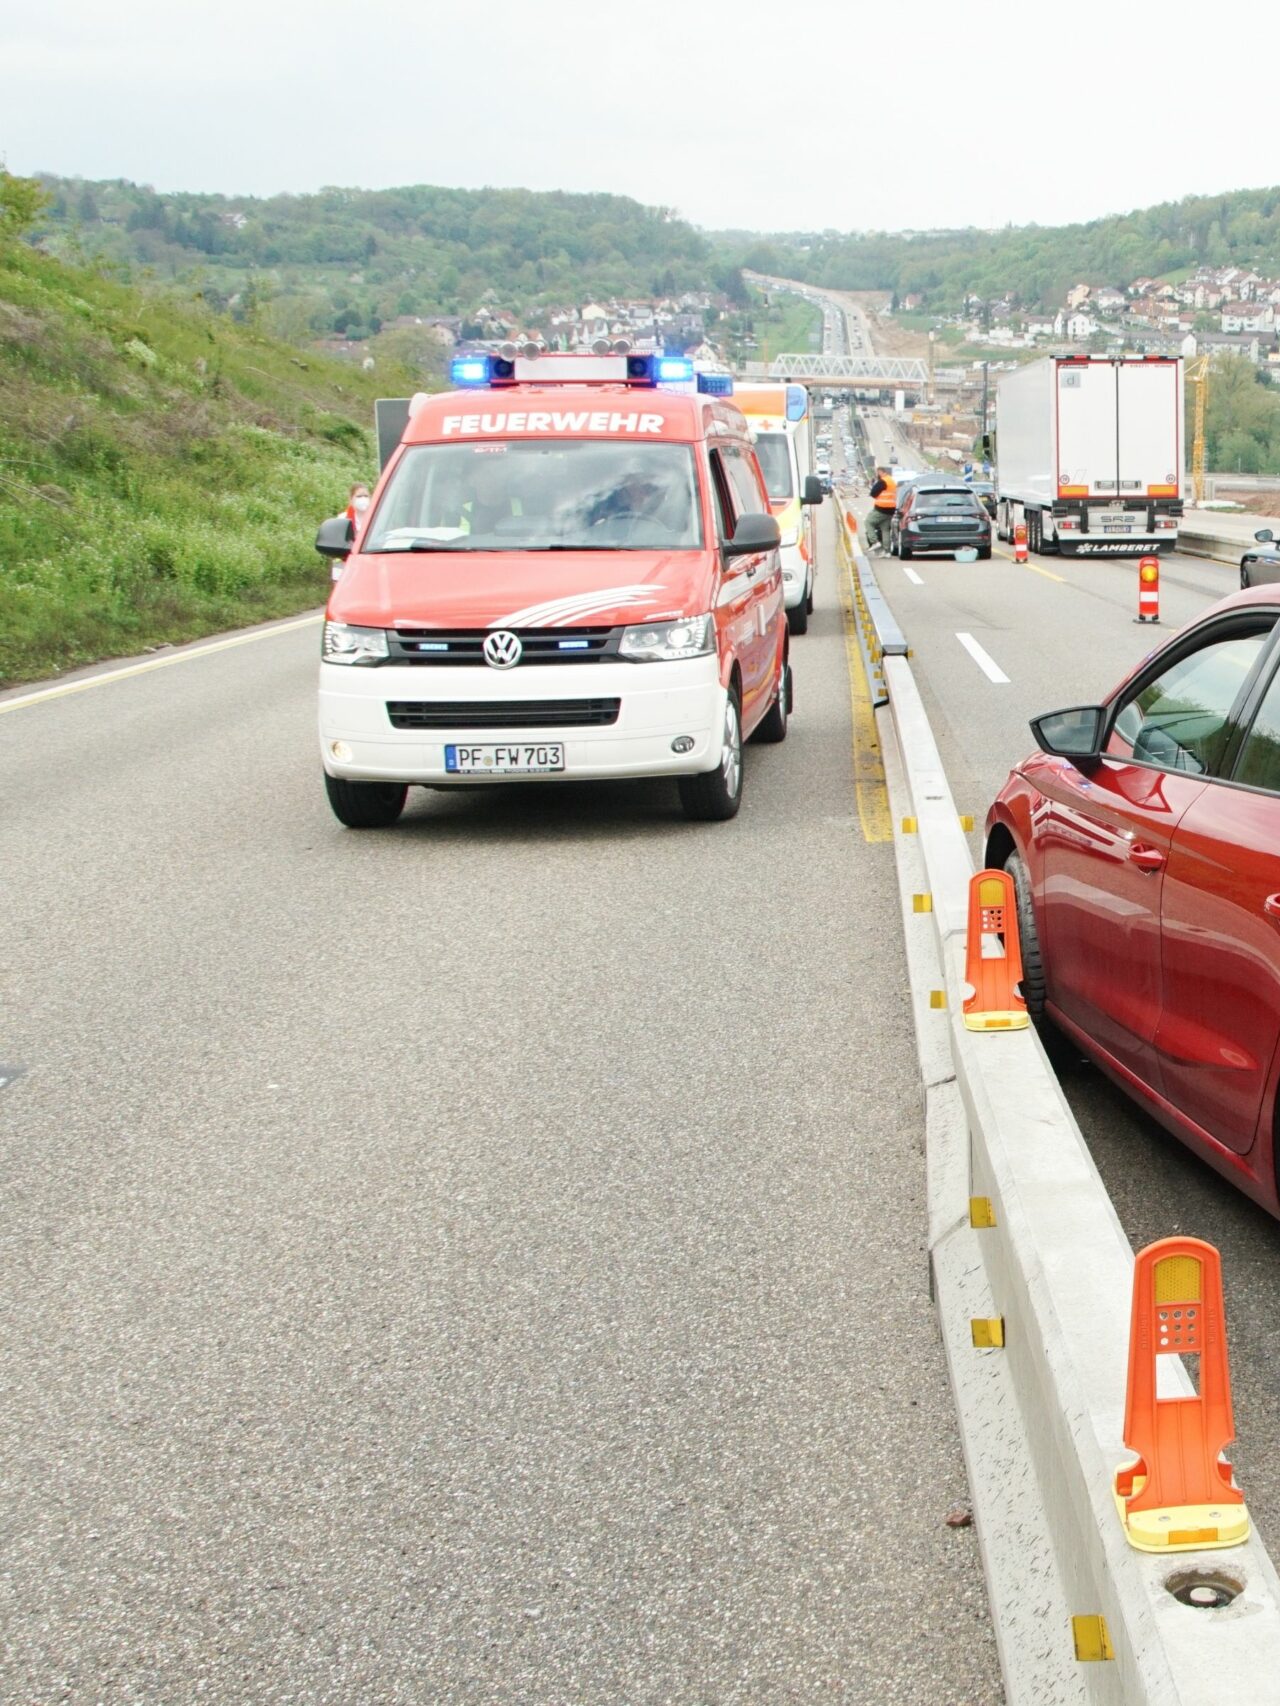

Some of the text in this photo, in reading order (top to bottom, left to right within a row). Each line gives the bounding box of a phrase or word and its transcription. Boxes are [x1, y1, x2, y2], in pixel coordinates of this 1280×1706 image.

[442, 412, 665, 436] FEUERWEHR
[1100, 515, 1136, 523] SR2
[1092, 543, 1161, 553] LAMBERET
[458, 747, 561, 766] PF FW 703
